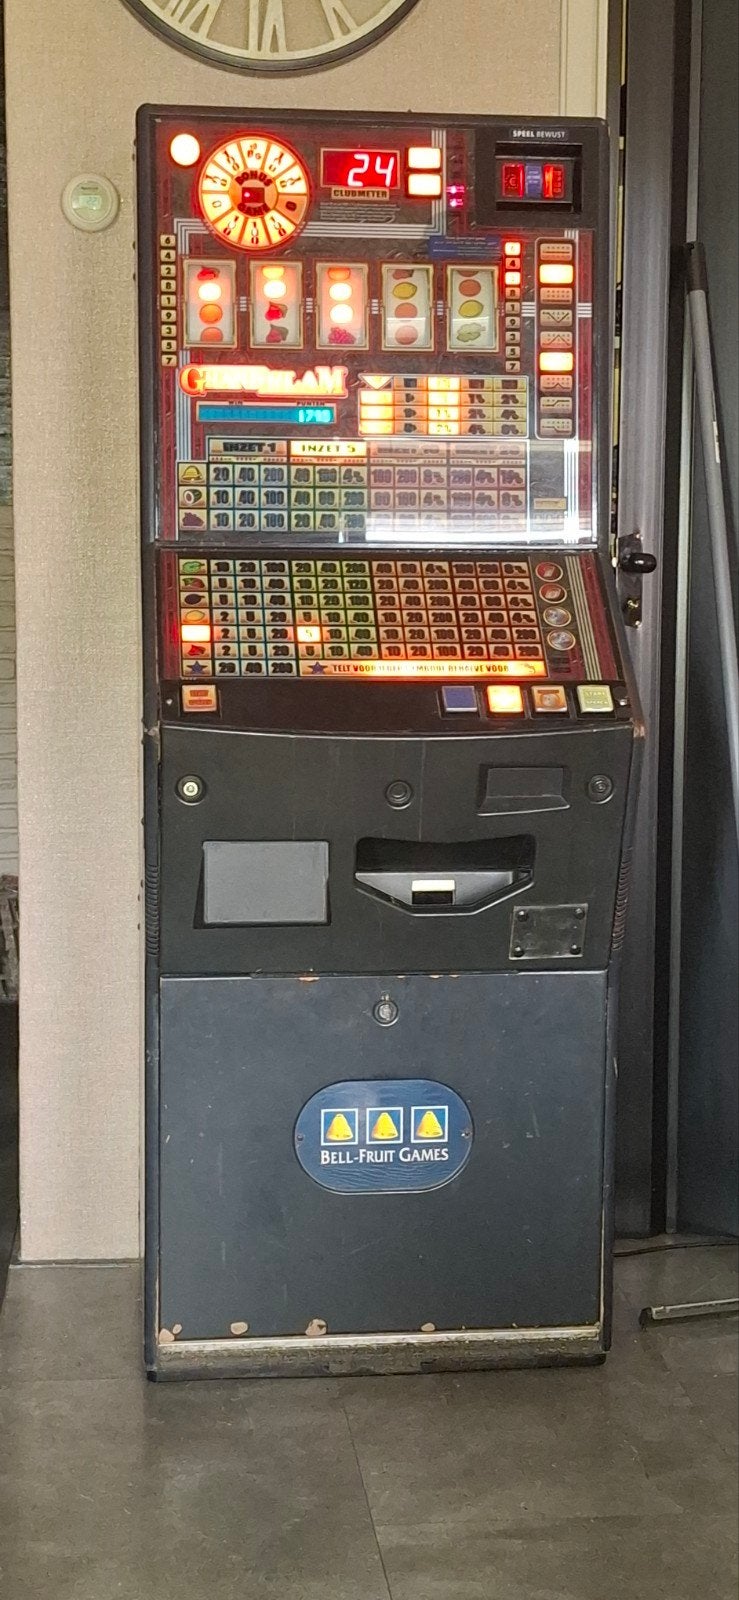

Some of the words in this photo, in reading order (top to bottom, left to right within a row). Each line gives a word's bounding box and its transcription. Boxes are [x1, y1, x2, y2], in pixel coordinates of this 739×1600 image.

[348, 153, 394, 186] 24
[235, 170, 273, 186] BONUS
[333, 189, 387, 198] CLUBMETER
[237, 202, 271, 216] GAME
[267, 443, 276, 452] 1
[213, 467, 230, 481] 20
[239, 467, 255, 481] 40
[264, 468, 284, 481] 200
[214, 489, 229, 504] 10
[264, 490, 284, 504] 100
[214, 512, 229, 526] 10
[239, 513, 255, 527] 20
[220, 611, 229, 621] 2
[381, 612, 397, 622] 10
[406, 612, 423, 622] 20
[432, 612, 452, 623] 200
[221, 628, 230, 638] 2
[222, 645, 230, 656] 2
[386, 646, 401, 656] 10
[410, 646, 427, 656] 20
[436, 646, 457, 656] 100
[320, 1149, 395, 1165] BELL-FRUIT
[399, 1147, 449, 1162] GAMES
